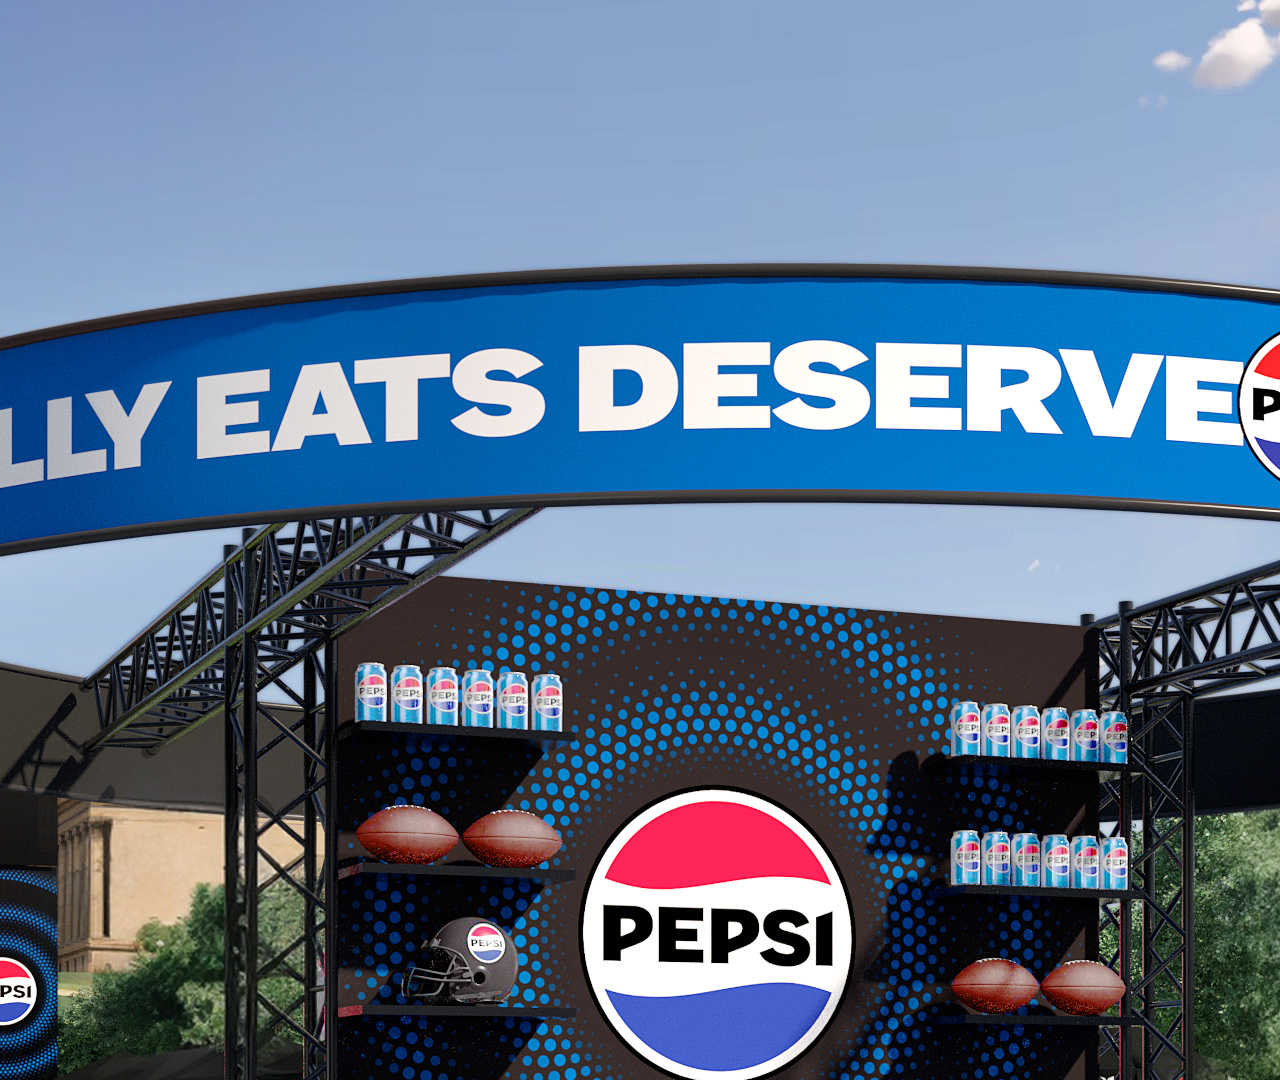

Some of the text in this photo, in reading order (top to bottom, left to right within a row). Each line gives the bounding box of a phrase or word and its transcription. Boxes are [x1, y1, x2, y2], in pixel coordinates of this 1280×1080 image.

[197, 348, 546, 460] EATS
[578, 339, 1245, 446] DESERVE
[359, 687, 386, 696] PEPS
[395, 689, 422, 698] PEPS
[431, 691, 457, 700] PEPS
[467, 693, 492, 702] PEPS
[502, 696, 527, 705] PEPS
[537, 698, 562, 706] PEPS
[602, 904, 833, 967] PEPSI
[471, 939, 503, 948] PEPSI
